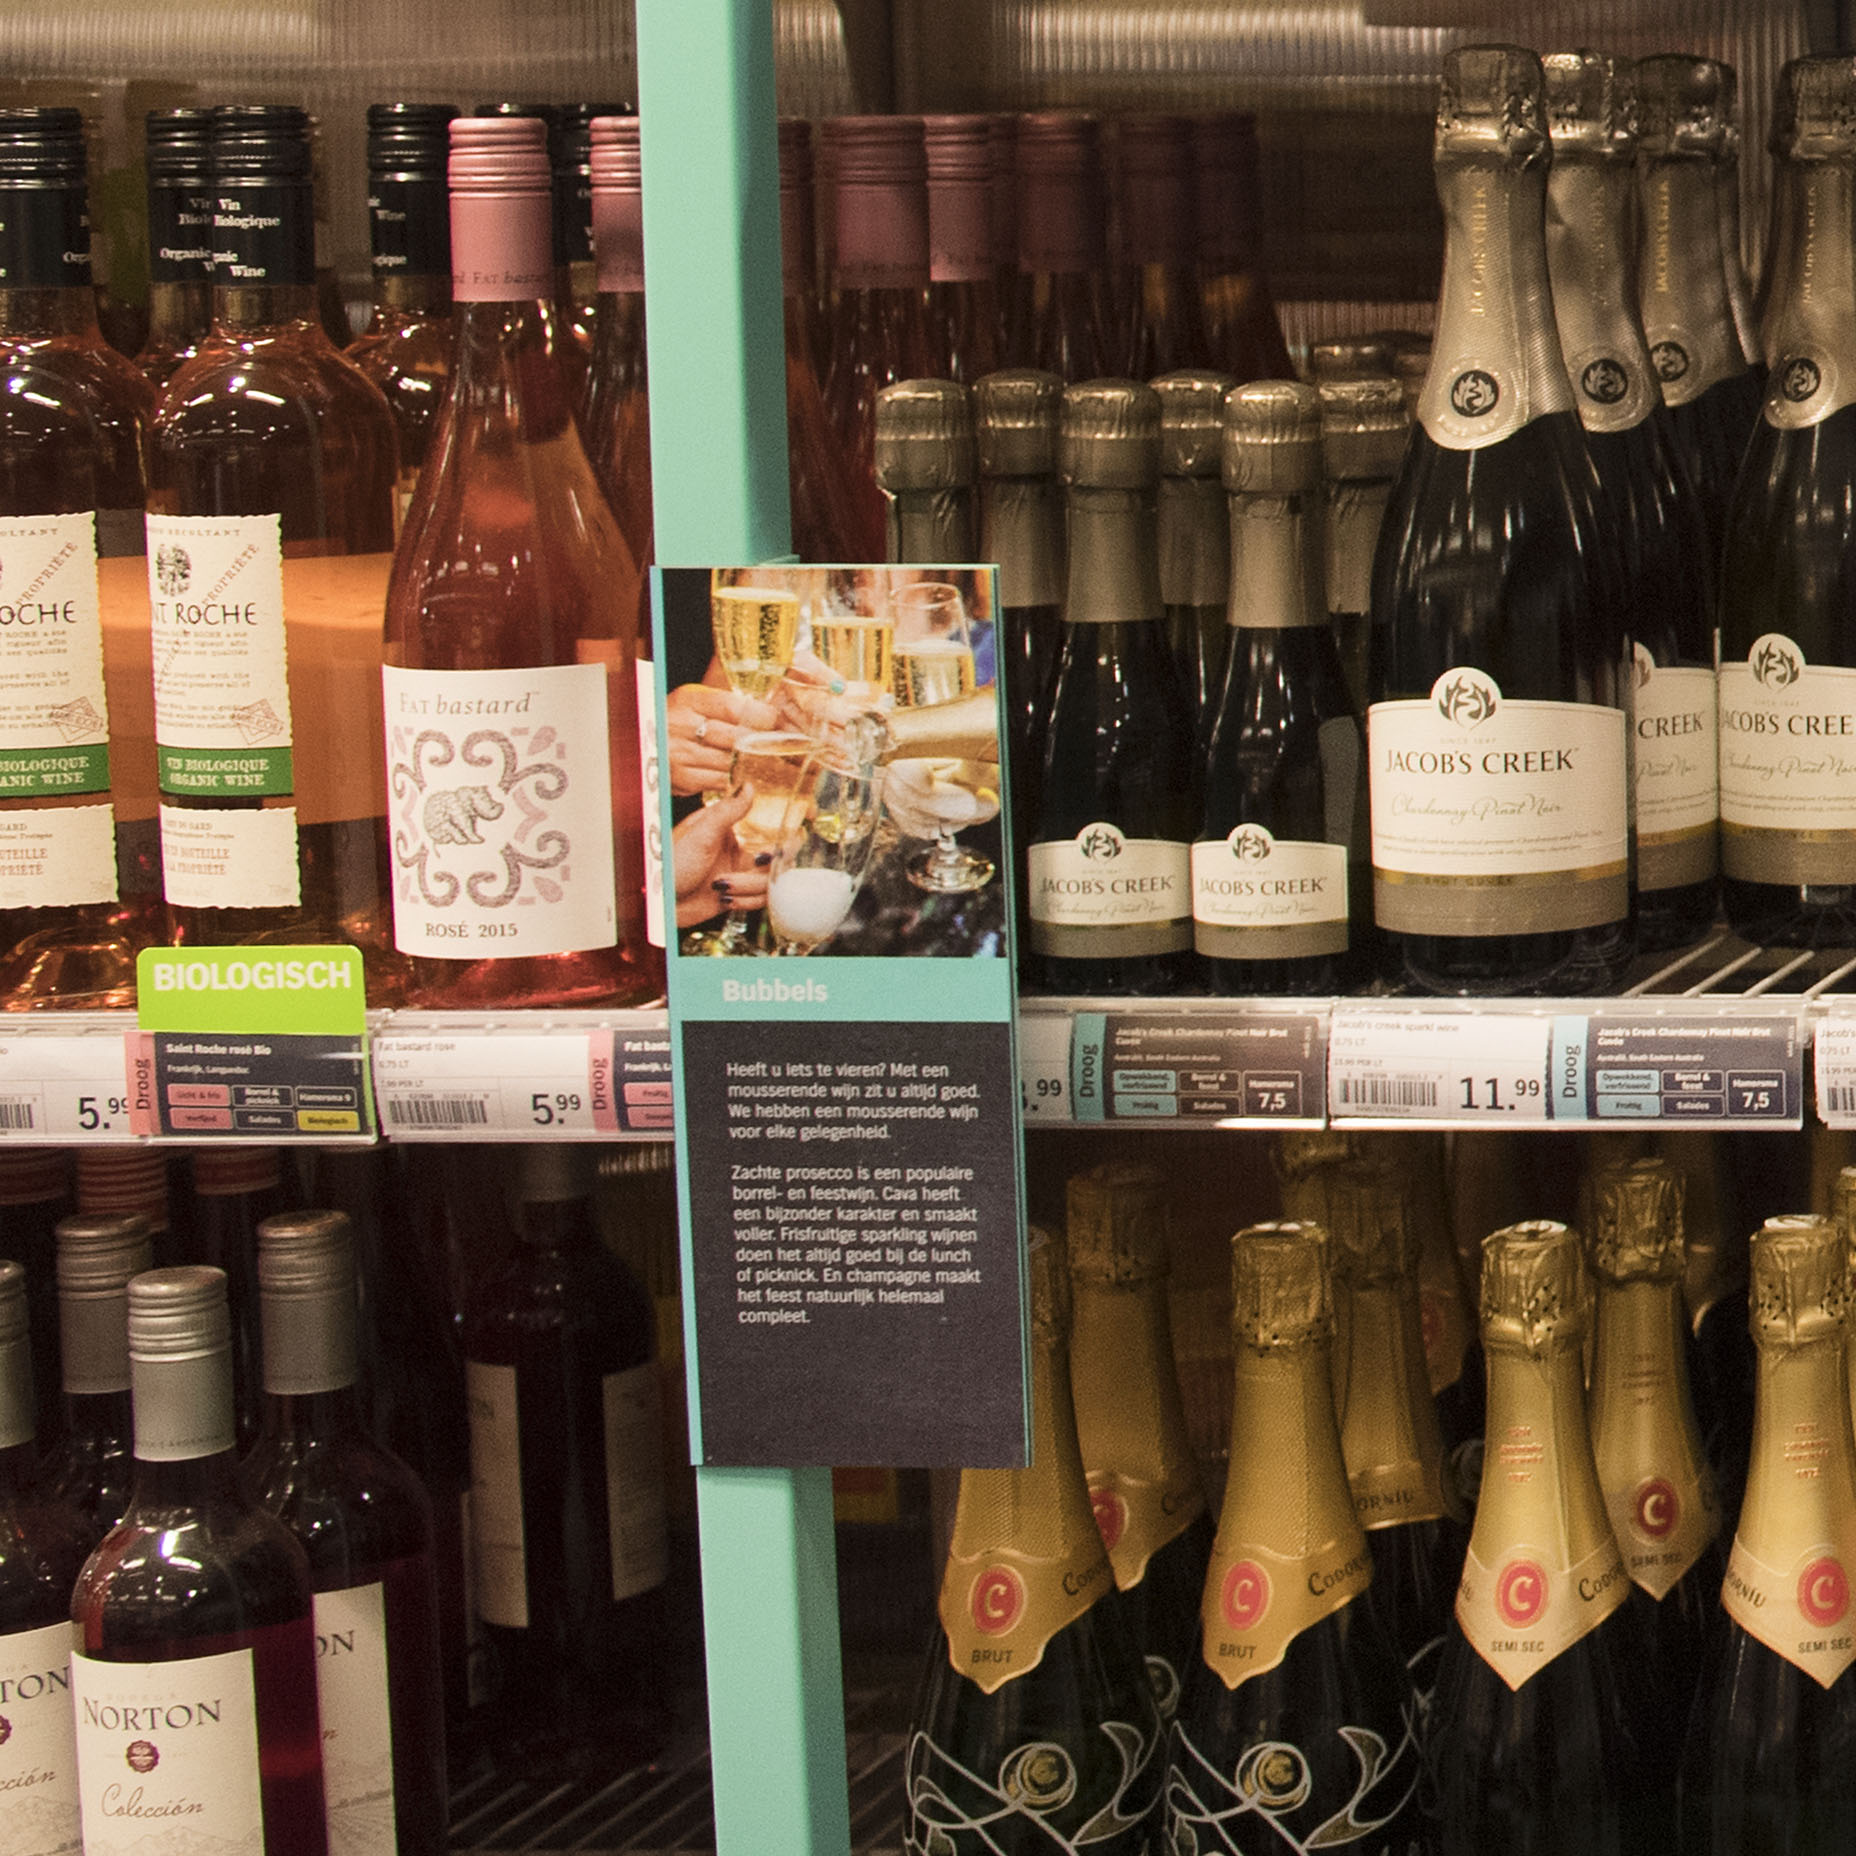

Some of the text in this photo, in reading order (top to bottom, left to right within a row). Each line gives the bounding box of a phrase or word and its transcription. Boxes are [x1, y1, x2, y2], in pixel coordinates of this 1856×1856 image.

[176, 602, 258, 625] ROCHE
[436, 693, 531, 715] bastard
[1385, 746, 1574, 775] JACOB'S CREEK
[426, 920, 518, 938] ROSÉ 2015
[154, 961, 351, 991] BIOLOGISCH
[723, 979, 828, 1002] Bubbels
[727, 1062, 949, 1077] Heeft u iets te vieren? Met een
[728, 1083, 980, 1101] mousserende wijn zit u altijd goed.
[729, 1104, 979, 1121] We hebben een mousserende wijn
[729, 1125, 891, 1142] voor elke gelegenheid.
[731, 1165, 973, 1184] Zachte prosecco is een populaire
[733, 1186, 960, 1204] borrel- en feestwijn. Cava heeft
[734, 1207, 977, 1224] een bijzonder karakter en smaakt
[734, 1227, 977, 1245] voller. Frisfruitige sparkling wijnen
[736, 1248, 971, 1266] doen het altijd goed bij de lunch
[736, 1268, 981, 1286] of picknick. En champagne maakt
[737, 1289, 944, 1307] het feest natuurlijk helemaal
[739, 1309, 810, 1326] compleet.
[82, 1695, 222, 1731] NORTON
[101, 1784, 204, 1819] Colección
